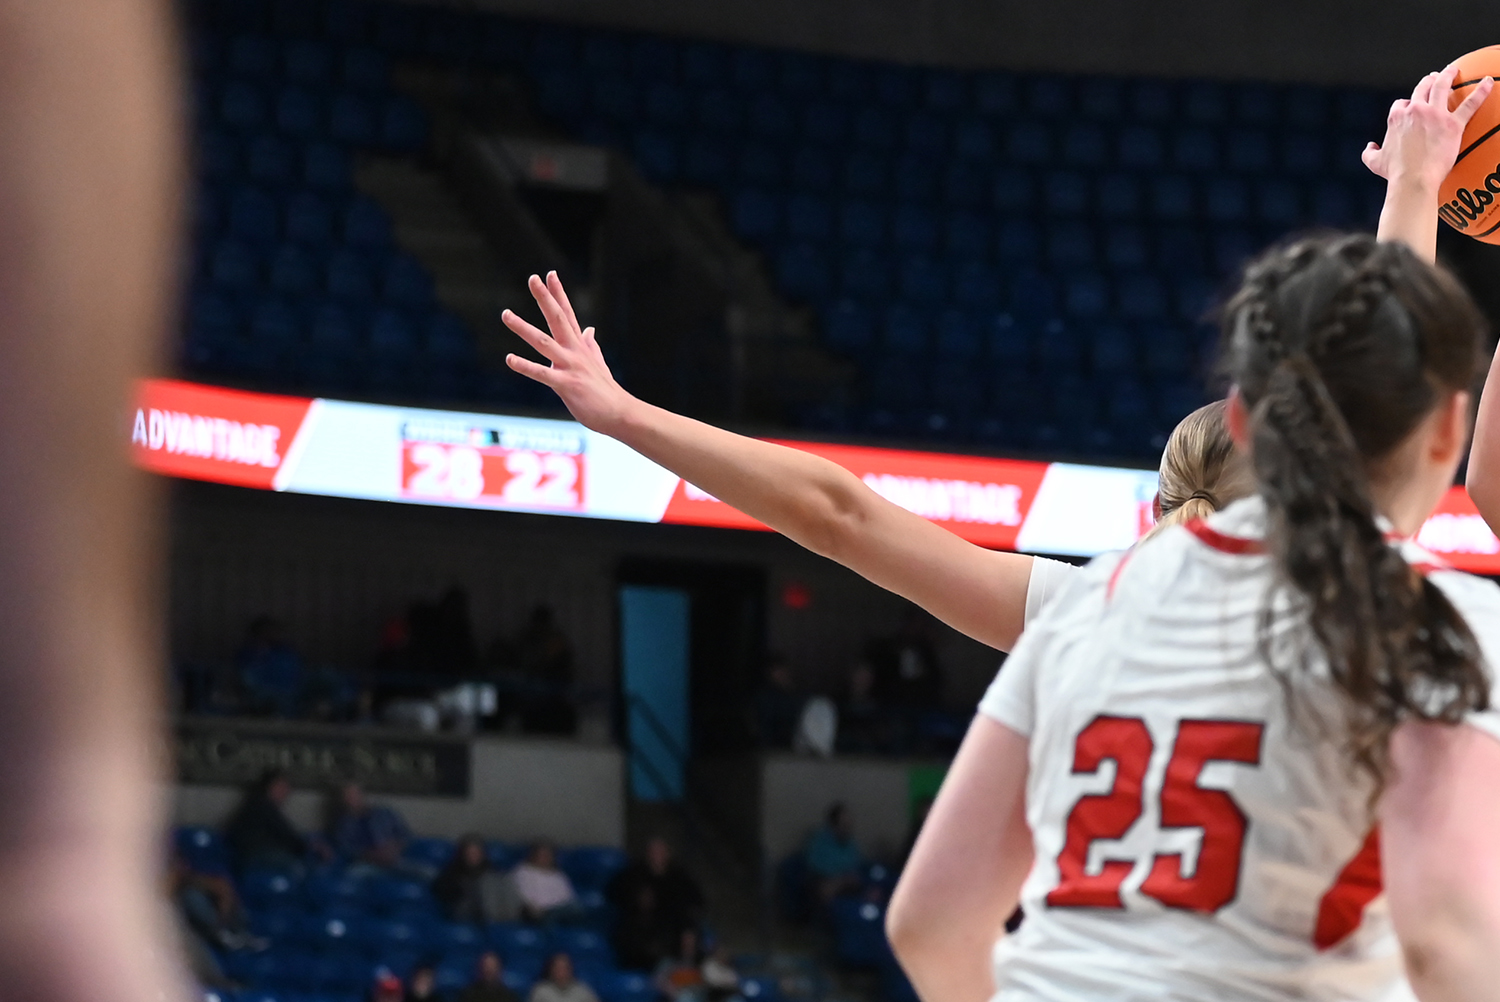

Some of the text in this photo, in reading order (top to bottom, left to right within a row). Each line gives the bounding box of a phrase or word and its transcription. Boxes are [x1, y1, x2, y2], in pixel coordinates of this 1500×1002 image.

[132, 407, 281, 468] ADVANTAGE
[504, 451, 578, 507] 22
[1045, 714, 1265, 914] 25
